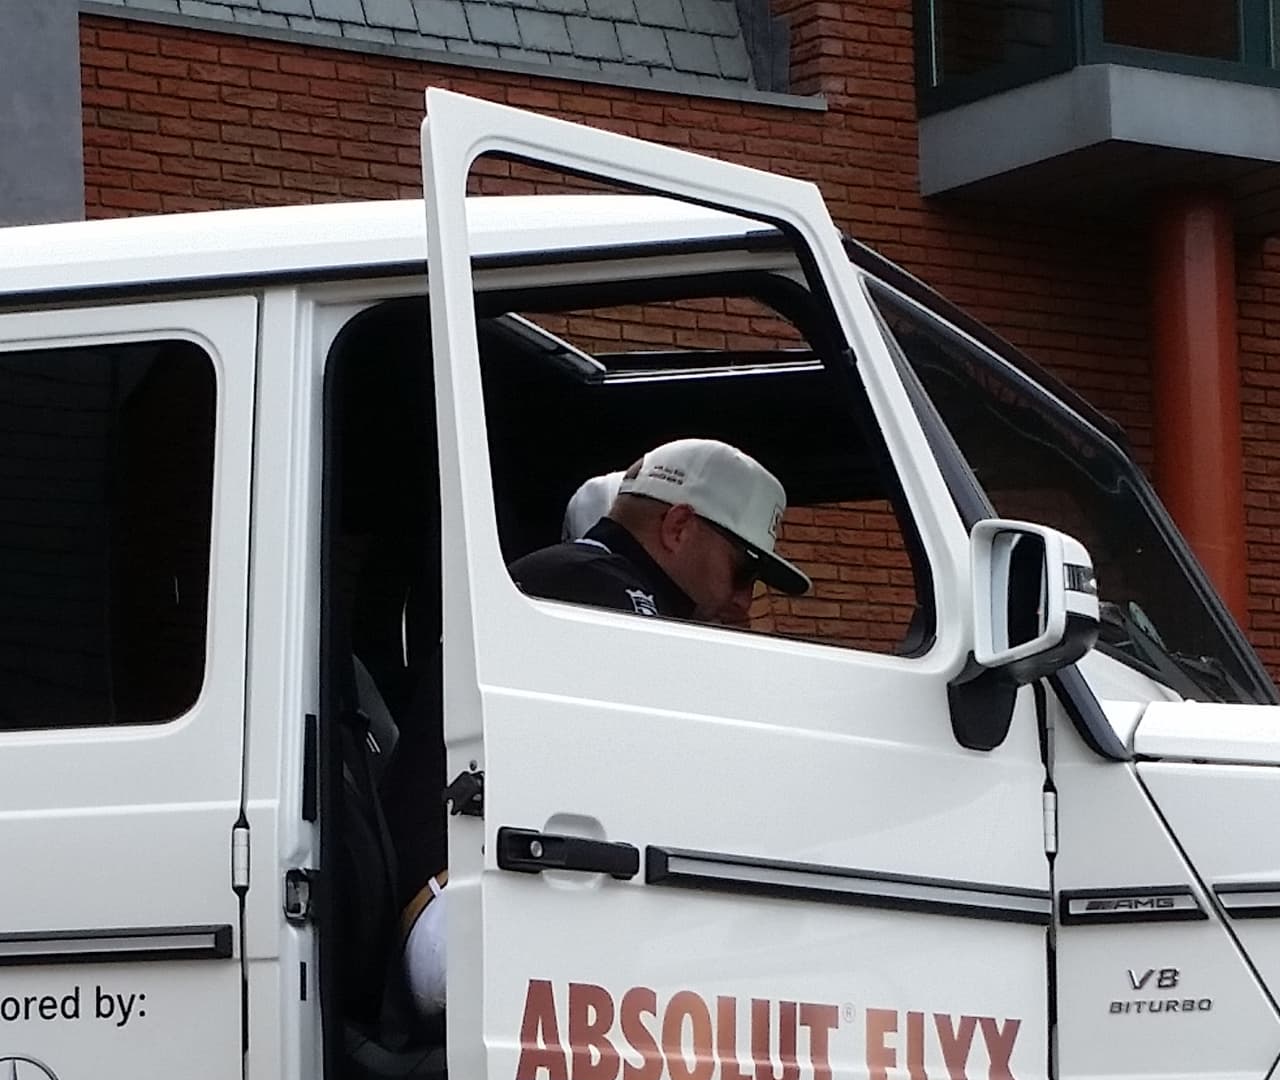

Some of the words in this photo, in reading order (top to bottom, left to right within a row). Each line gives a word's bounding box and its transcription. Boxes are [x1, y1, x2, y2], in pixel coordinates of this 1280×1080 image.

[1113, 897, 1175, 909] AMG
[1128, 968, 1180, 990] V8
[95, 985, 147, 1027] by:
[1109, 998, 1212, 1014] BITURBO
